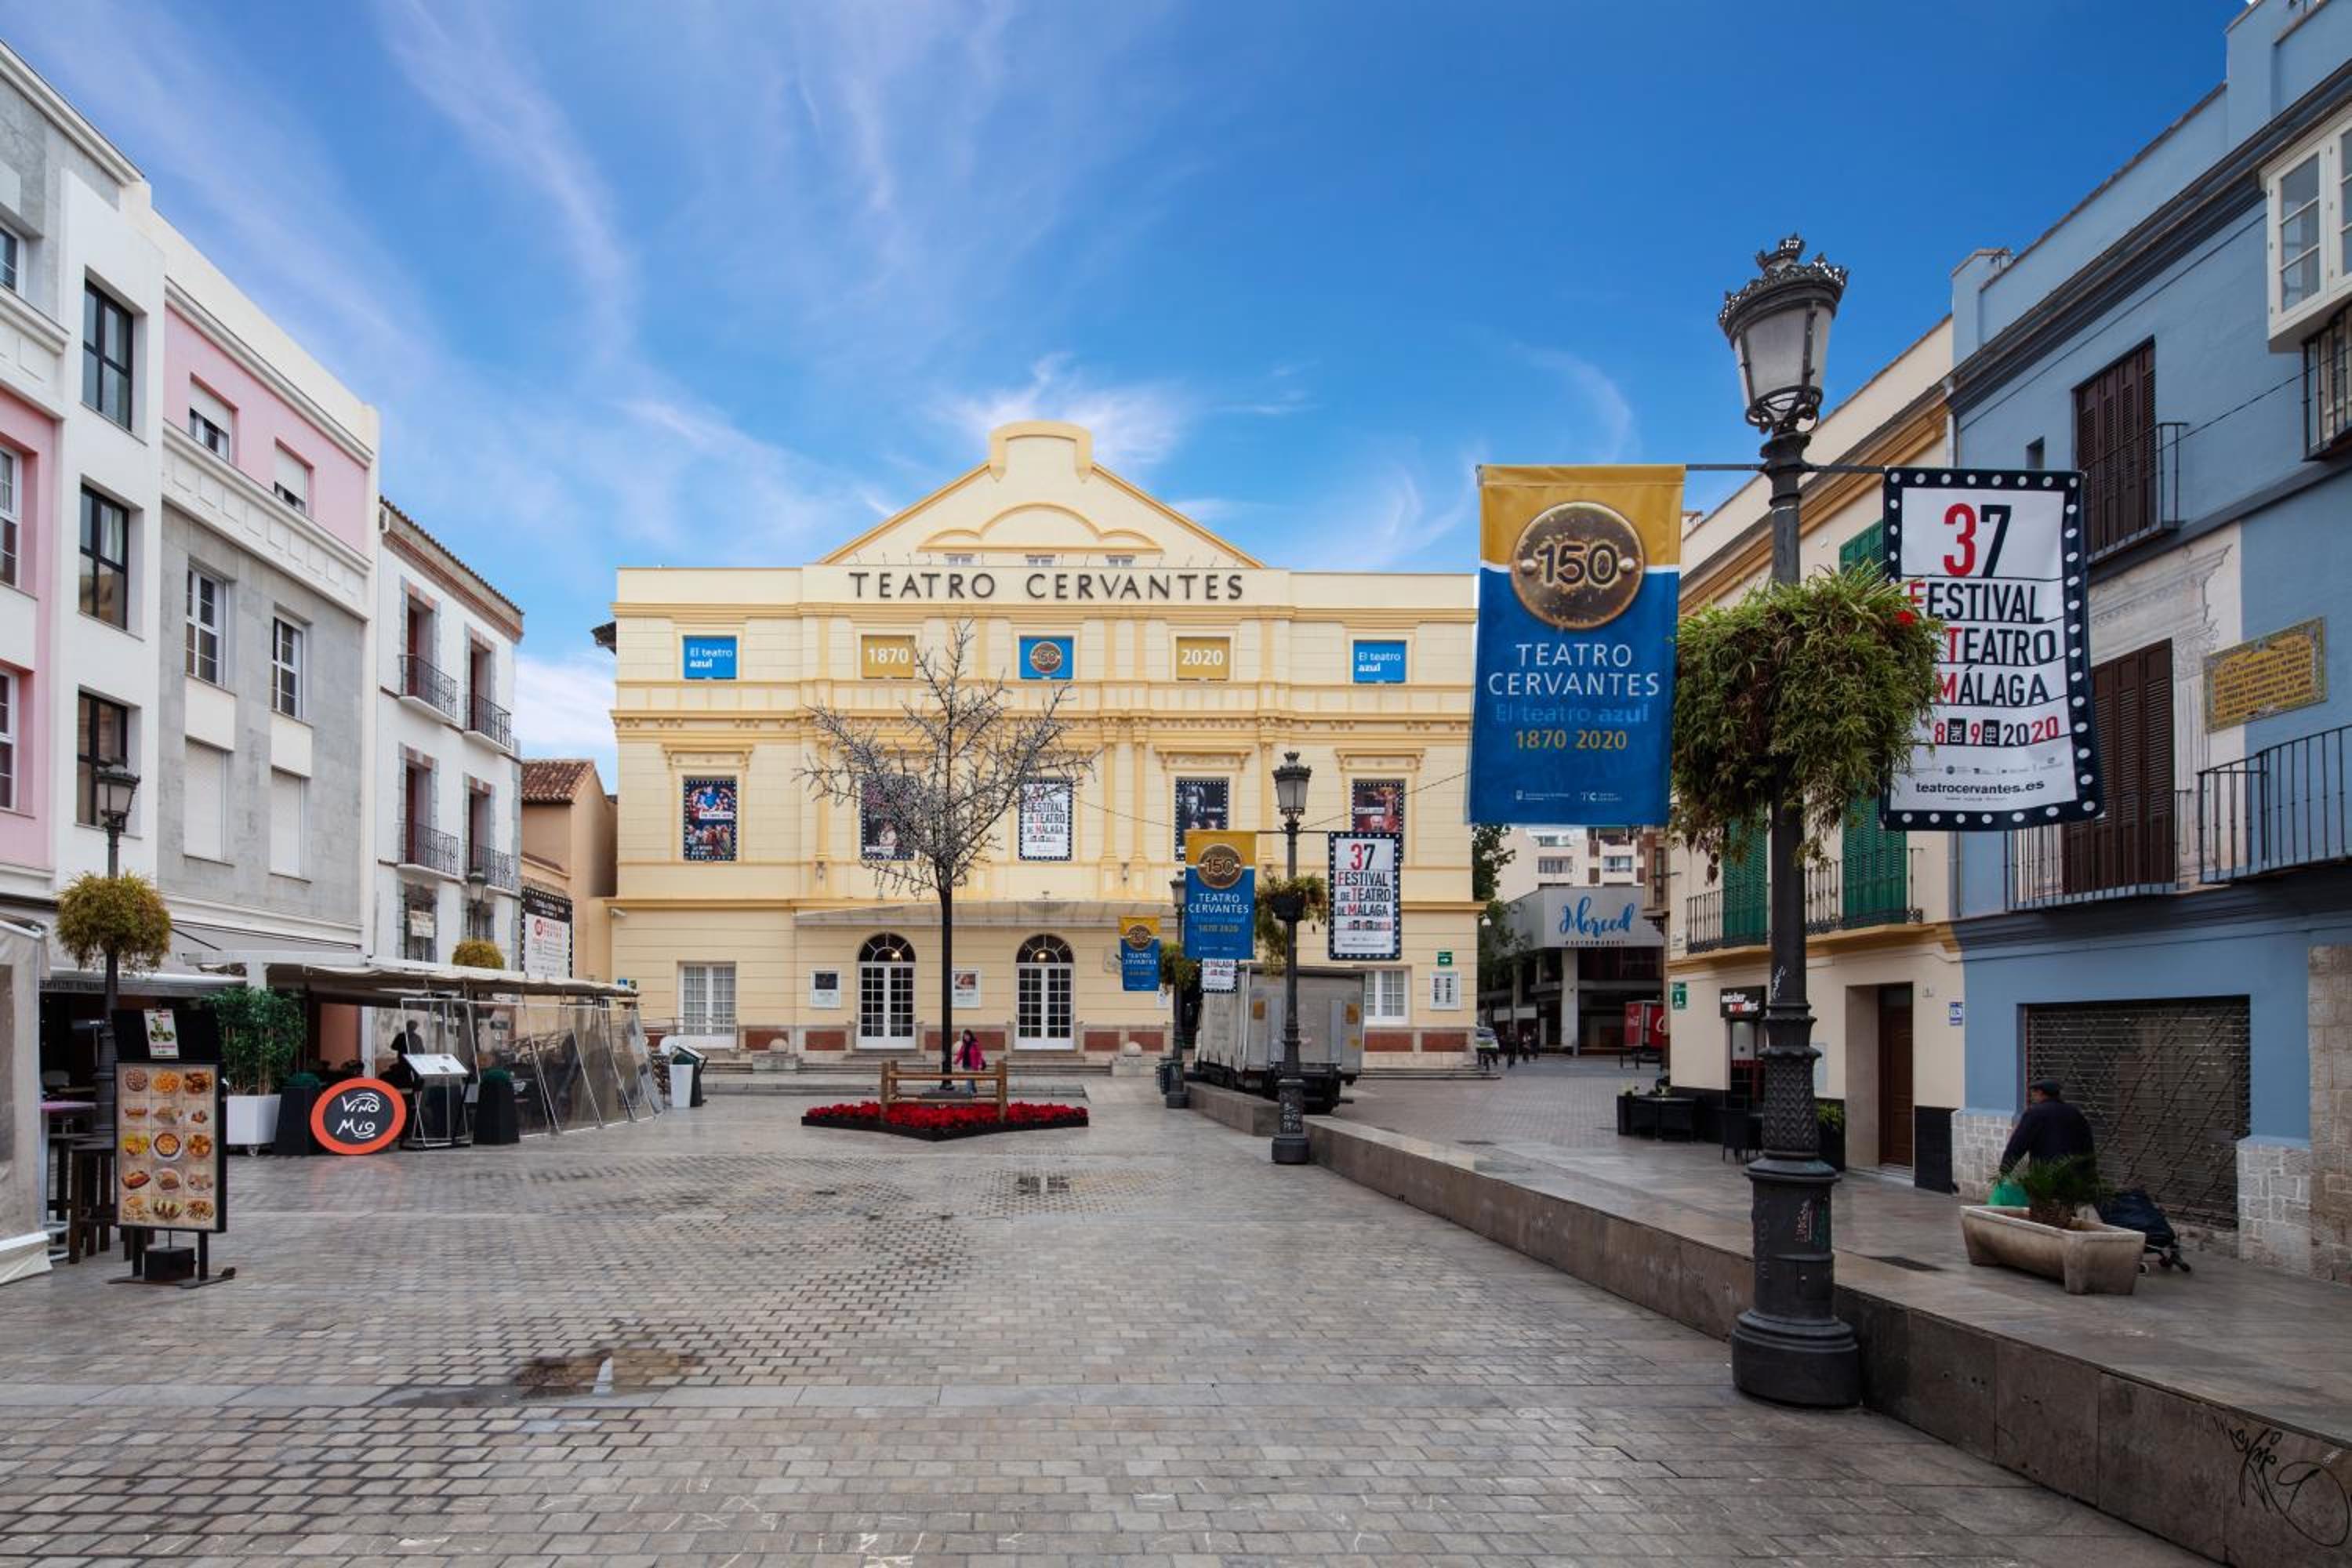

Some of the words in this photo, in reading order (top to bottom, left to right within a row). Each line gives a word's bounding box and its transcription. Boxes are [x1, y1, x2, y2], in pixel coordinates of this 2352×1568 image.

[1944, 503, 2012, 579] 37
[1537, 543, 1618, 586] 150
[849, 572, 996, 599] TEATRO
[1026, 573, 1243, 601] CERVANTES
[1908, 582, 2045, 624] FESTIVAL
[690, 647, 699, 659] El
[702, 647, 733, 659] teatro
[1945, 626, 2057, 666] TEATRO
[690, 658, 713, 669] azul
[868, 648, 909, 664] 1870
[1181, 649, 1223, 666] 2020
[1359, 652, 1368, 662] El
[1370, 652, 1401, 662] teatro
[1515, 643, 1632, 667] TEATRO
[1358, 662, 1381, 672] azul
[1489, 672, 1660, 697] CERVANTES
[1936, 664, 2050, 706] MÁLAGA
[1496, 705, 1513, 722] El
[1523, 706, 1591, 722] teatro
[1598, 704, 1650, 722] azul
[1515, 729, 1567, 750] 1870
[1576, 730, 1628, 750] 2020
[1934, 722, 1945, 745] 8
[1970, 723, 1981, 746] 9
[2003, 716, 2059, 746] 2020
[1915, 780, 2045, 794] teatrocervantes.es
[1350, 843, 1376, 871] 37
[1206, 858, 1234, 874] 150
[1338, 871, 1388, 887] FESTIVAL
[1199, 894, 1240, 903] TEATRO
[1341, 892, 1350, 901] DE
[1351, 887, 1392, 902] TEATRO
[1188, 905, 1249, 913] CERVANTES
[1338, 906, 1346, 916] DE
[1559, 895, 1635, 938] Merced
